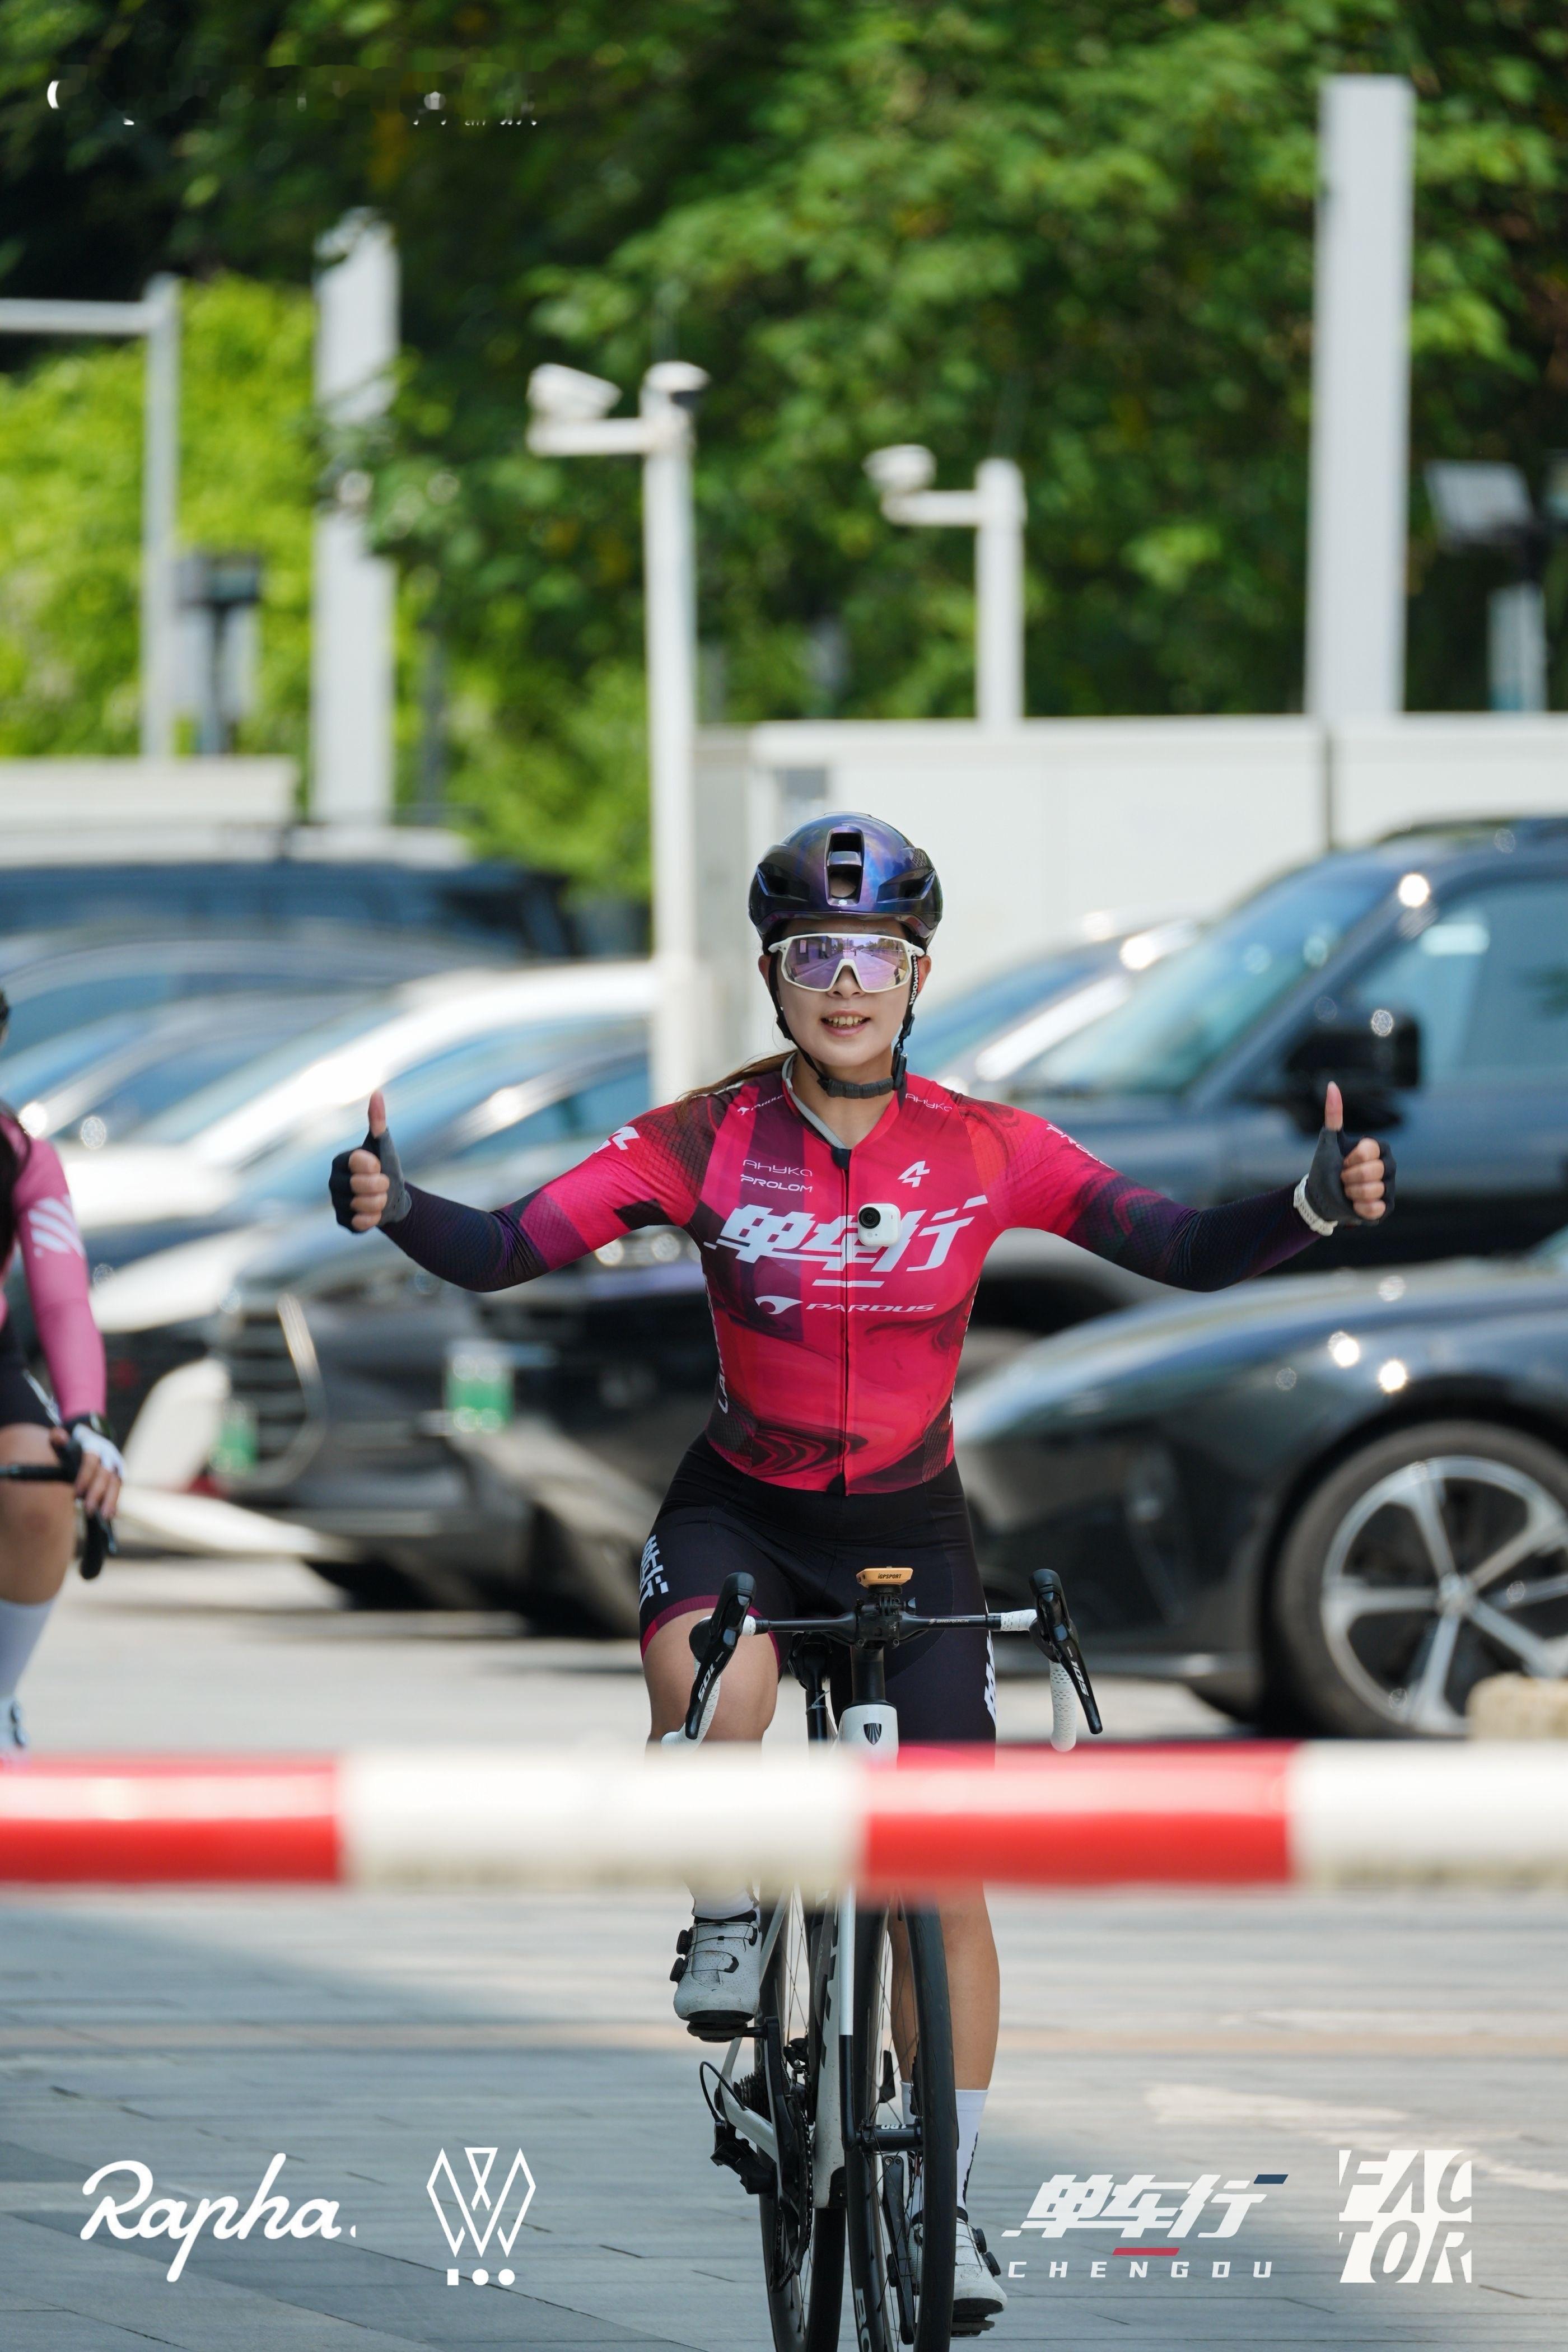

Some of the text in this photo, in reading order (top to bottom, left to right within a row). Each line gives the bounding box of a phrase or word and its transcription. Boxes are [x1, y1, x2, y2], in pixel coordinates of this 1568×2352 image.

[740, 1174, 813, 1193] PROLOM
[805, 1303, 937, 1313] PARDUS
[698, 1663, 716, 1702] 105
[1070, 1660, 1090, 1697] 105
